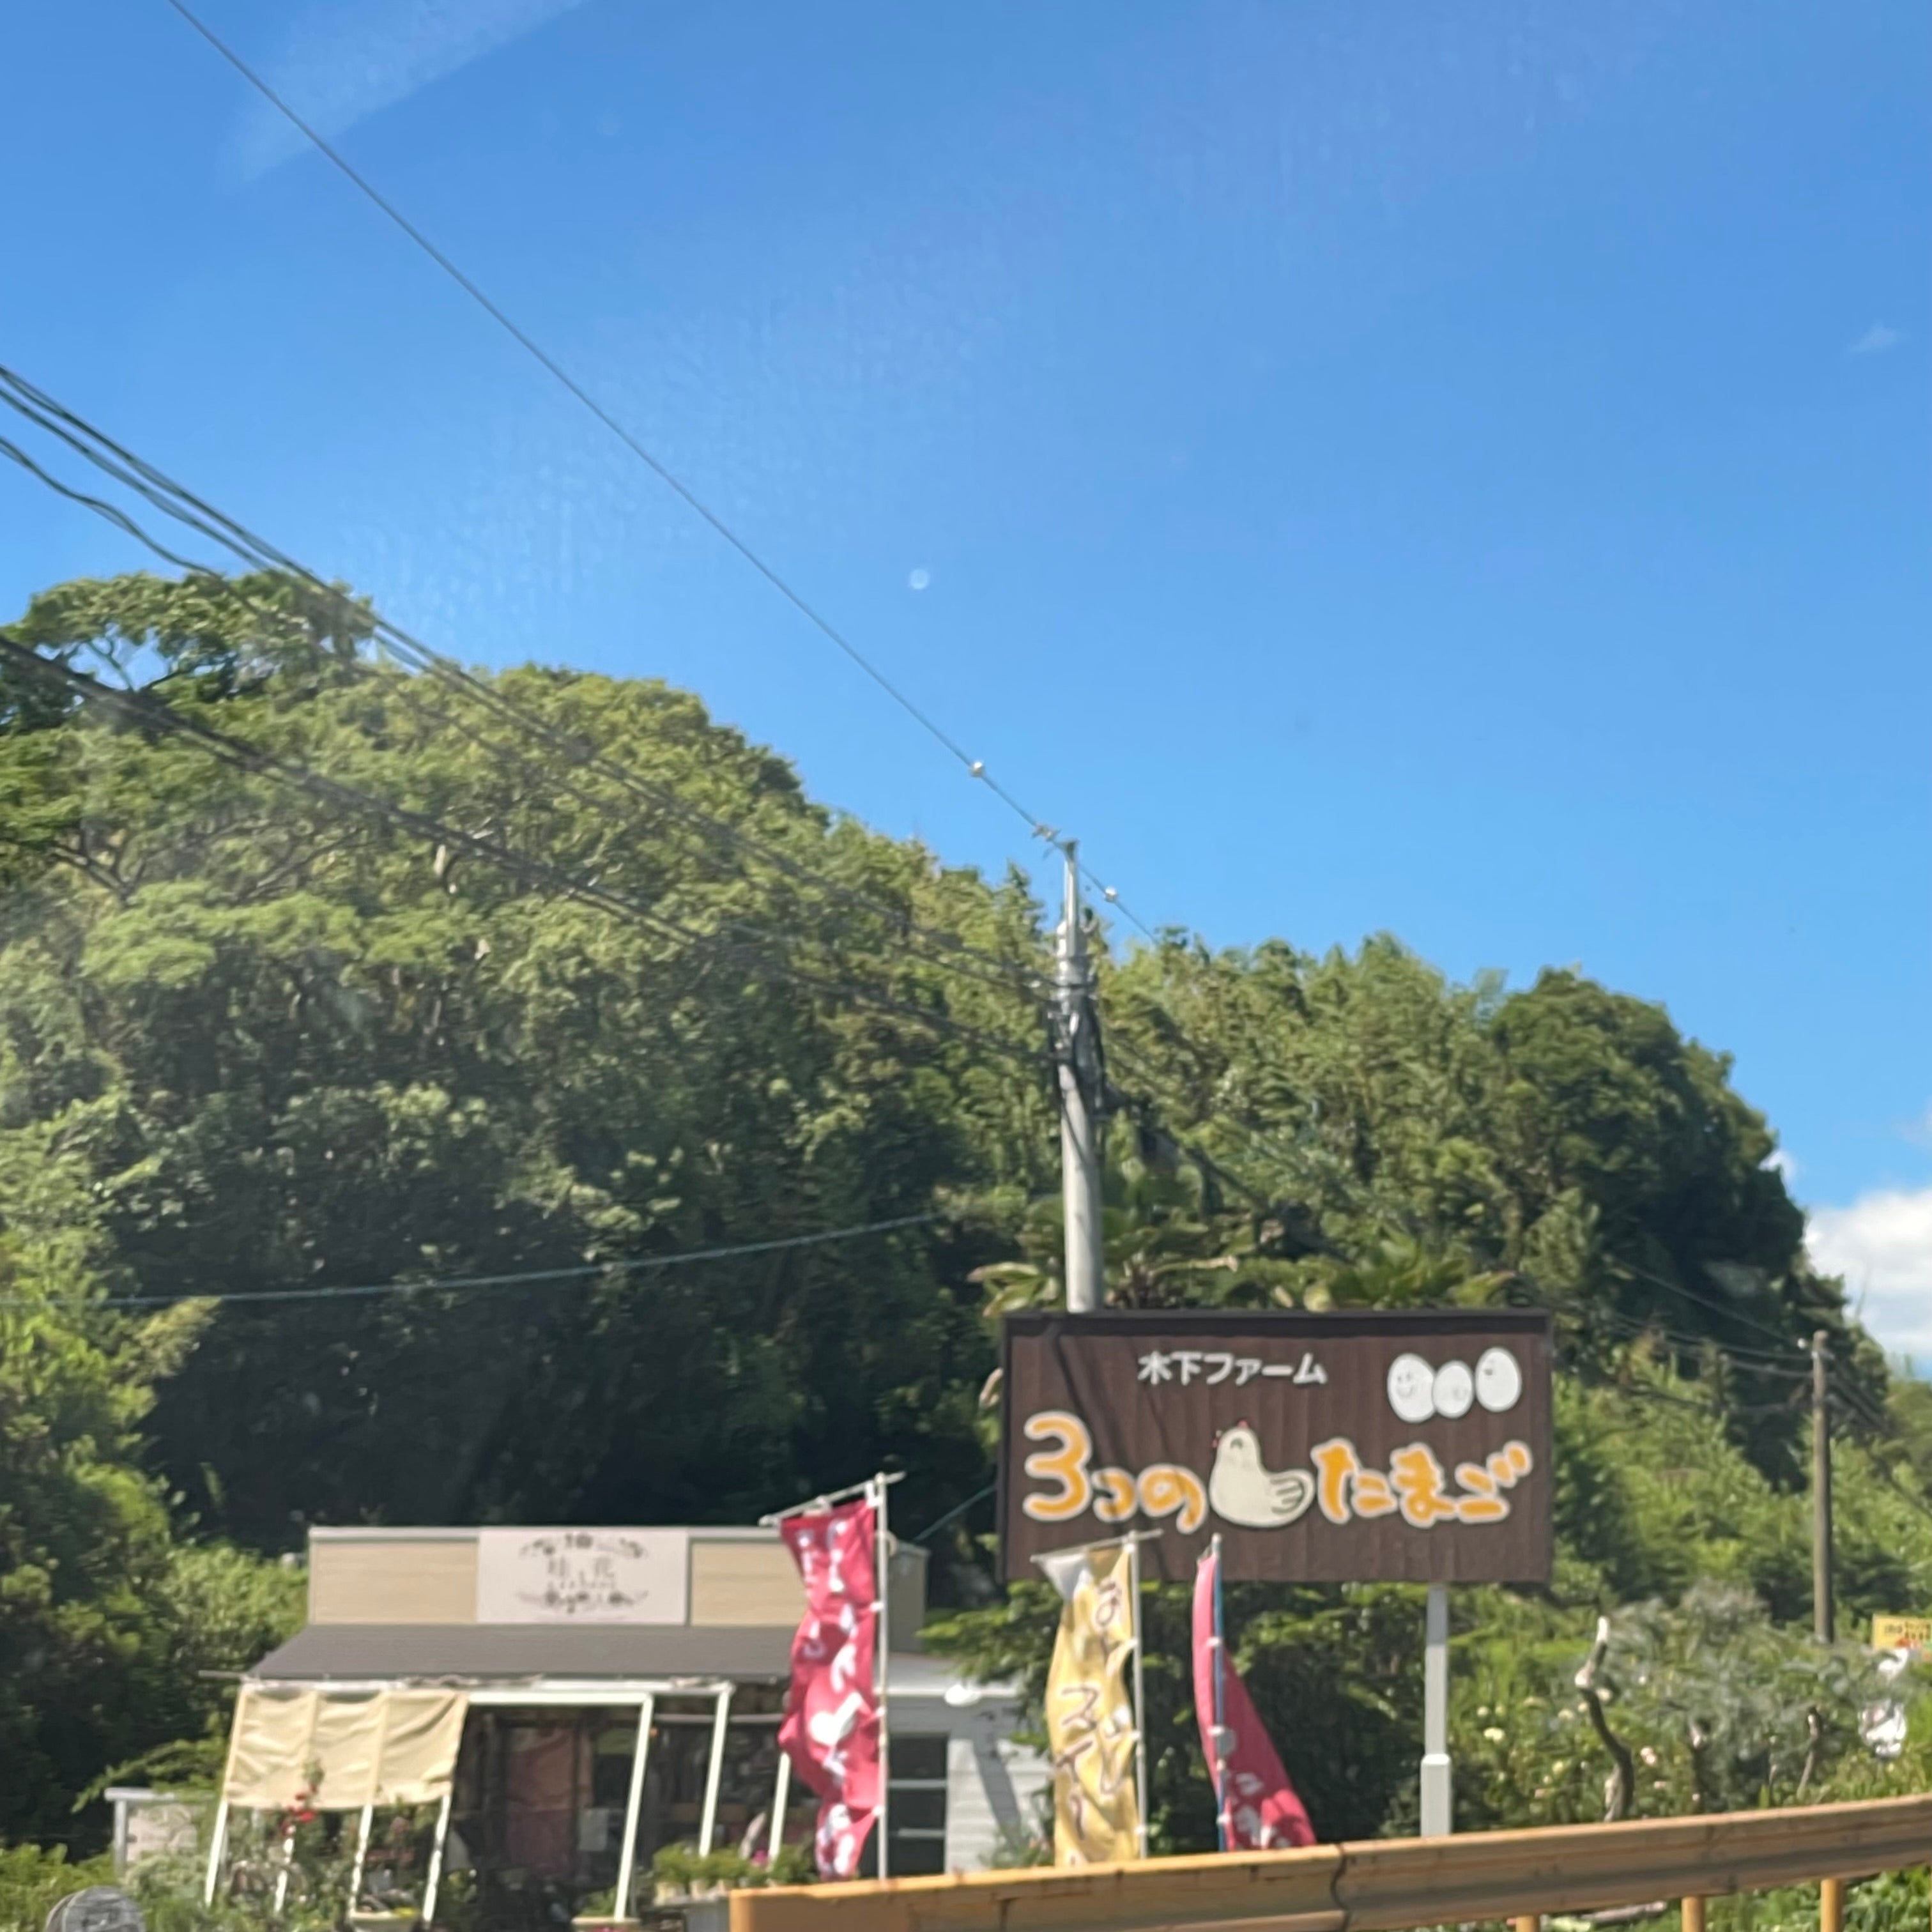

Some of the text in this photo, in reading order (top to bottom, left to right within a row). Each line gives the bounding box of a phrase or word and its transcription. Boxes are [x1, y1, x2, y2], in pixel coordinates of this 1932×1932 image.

[1137, 1350, 1328, 1386] 木下ファーム
[1311, 1438, 1533, 1528] たまご
